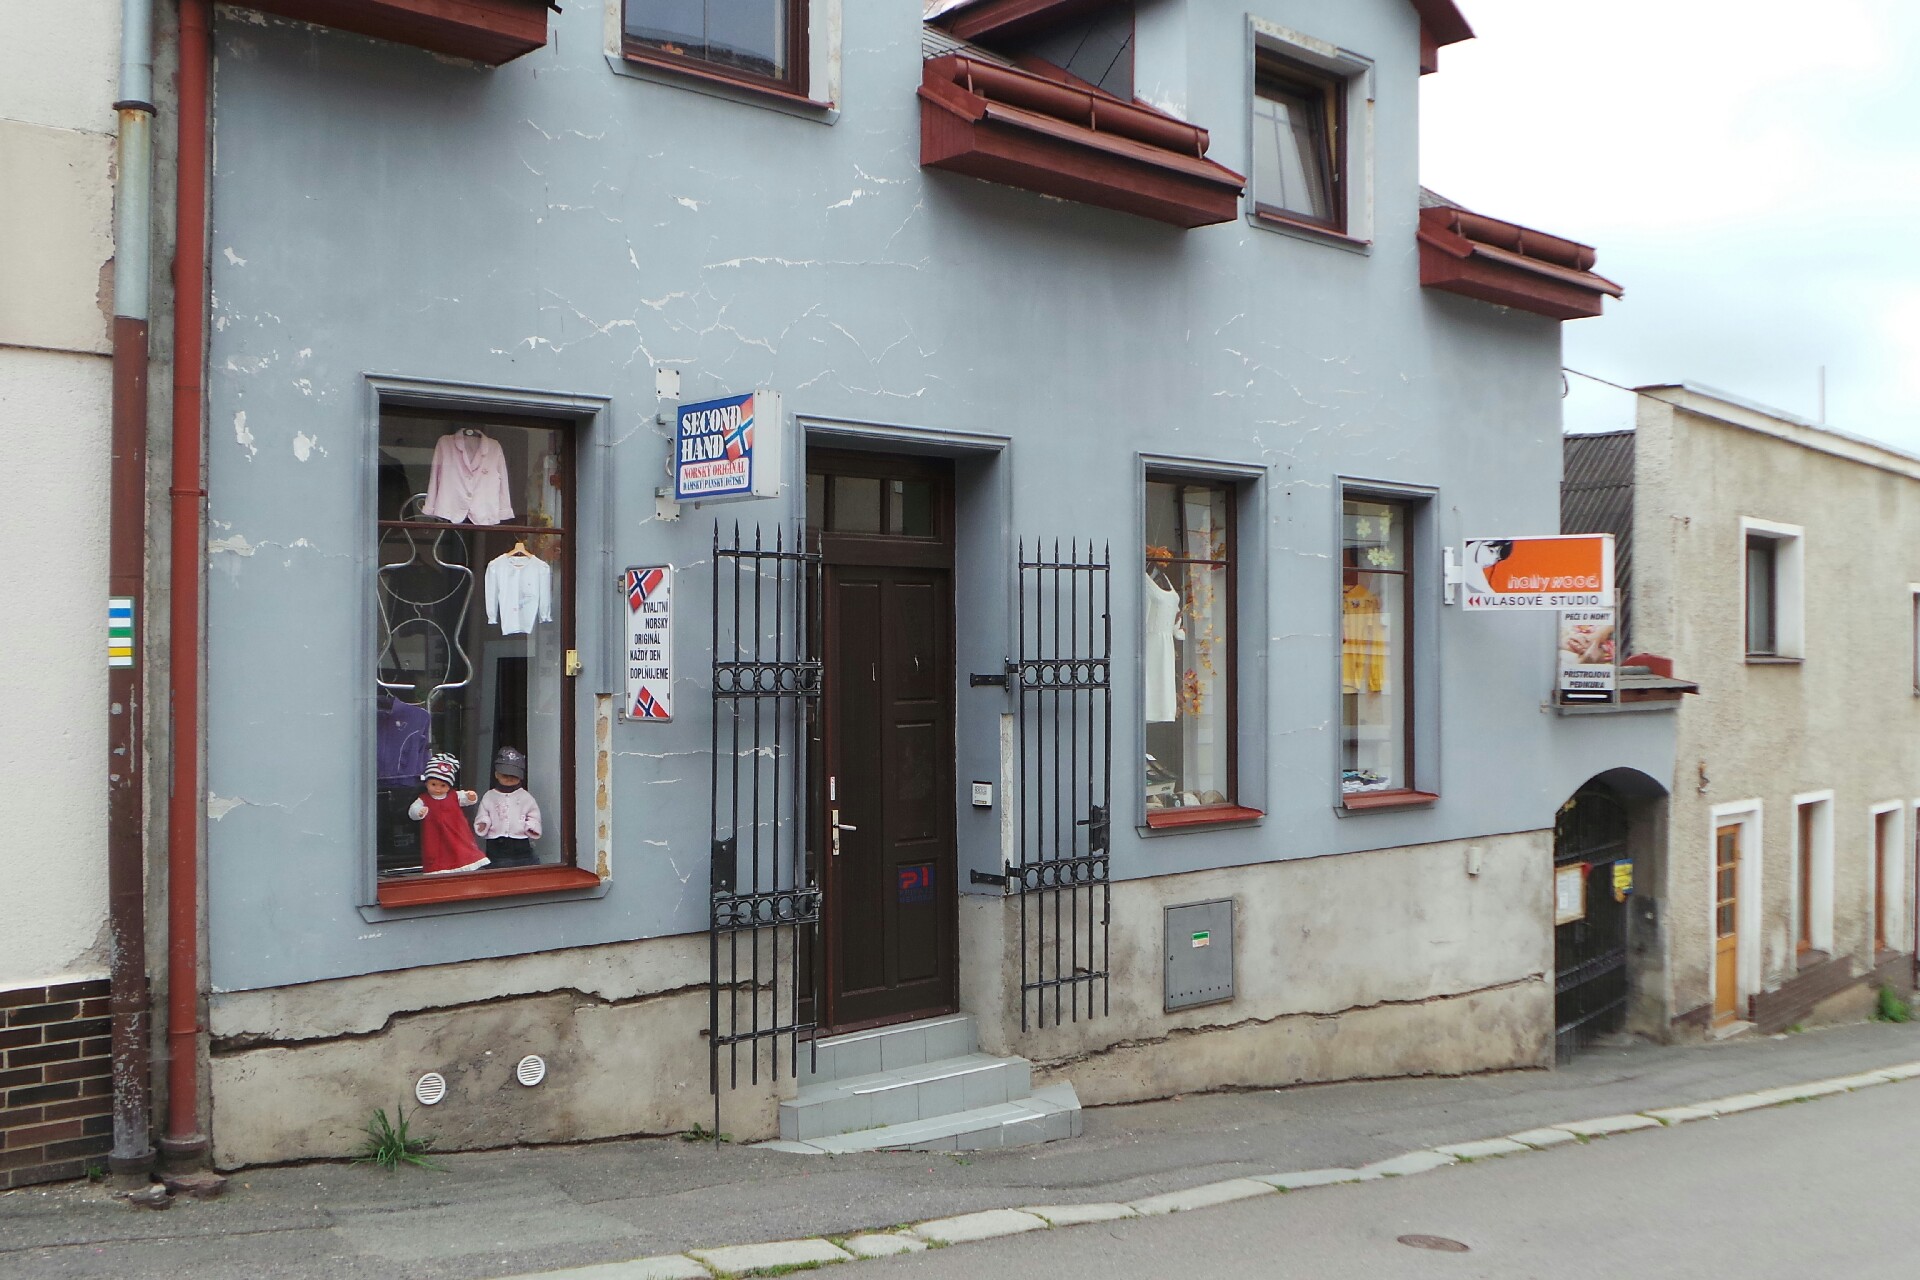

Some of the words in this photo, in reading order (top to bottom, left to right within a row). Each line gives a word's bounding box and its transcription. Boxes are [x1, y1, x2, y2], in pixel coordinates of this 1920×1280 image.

[682, 405, 742, 436] SECOND
[681, 434, 724, 462] HAND
[684, 463, 711, 480] NORSKÝ
[713, 460, 745, 476] ORIGINÁL
[643, 598, 668, 613] KVALITNÍ
[1483, 593, 1543, 606] VLASOVÉ
[1550, 594, 1599, 606] STUDIO
[645, 614, 668, 629] NORSKÝ
[634, 630, 661, 645] ORIGINÁL
[630, 648, 647, 661] KAŽDÝ
[650, 650, 661, 661] DEN
[630, 665, 668, 679] DOPLŇUJEME
